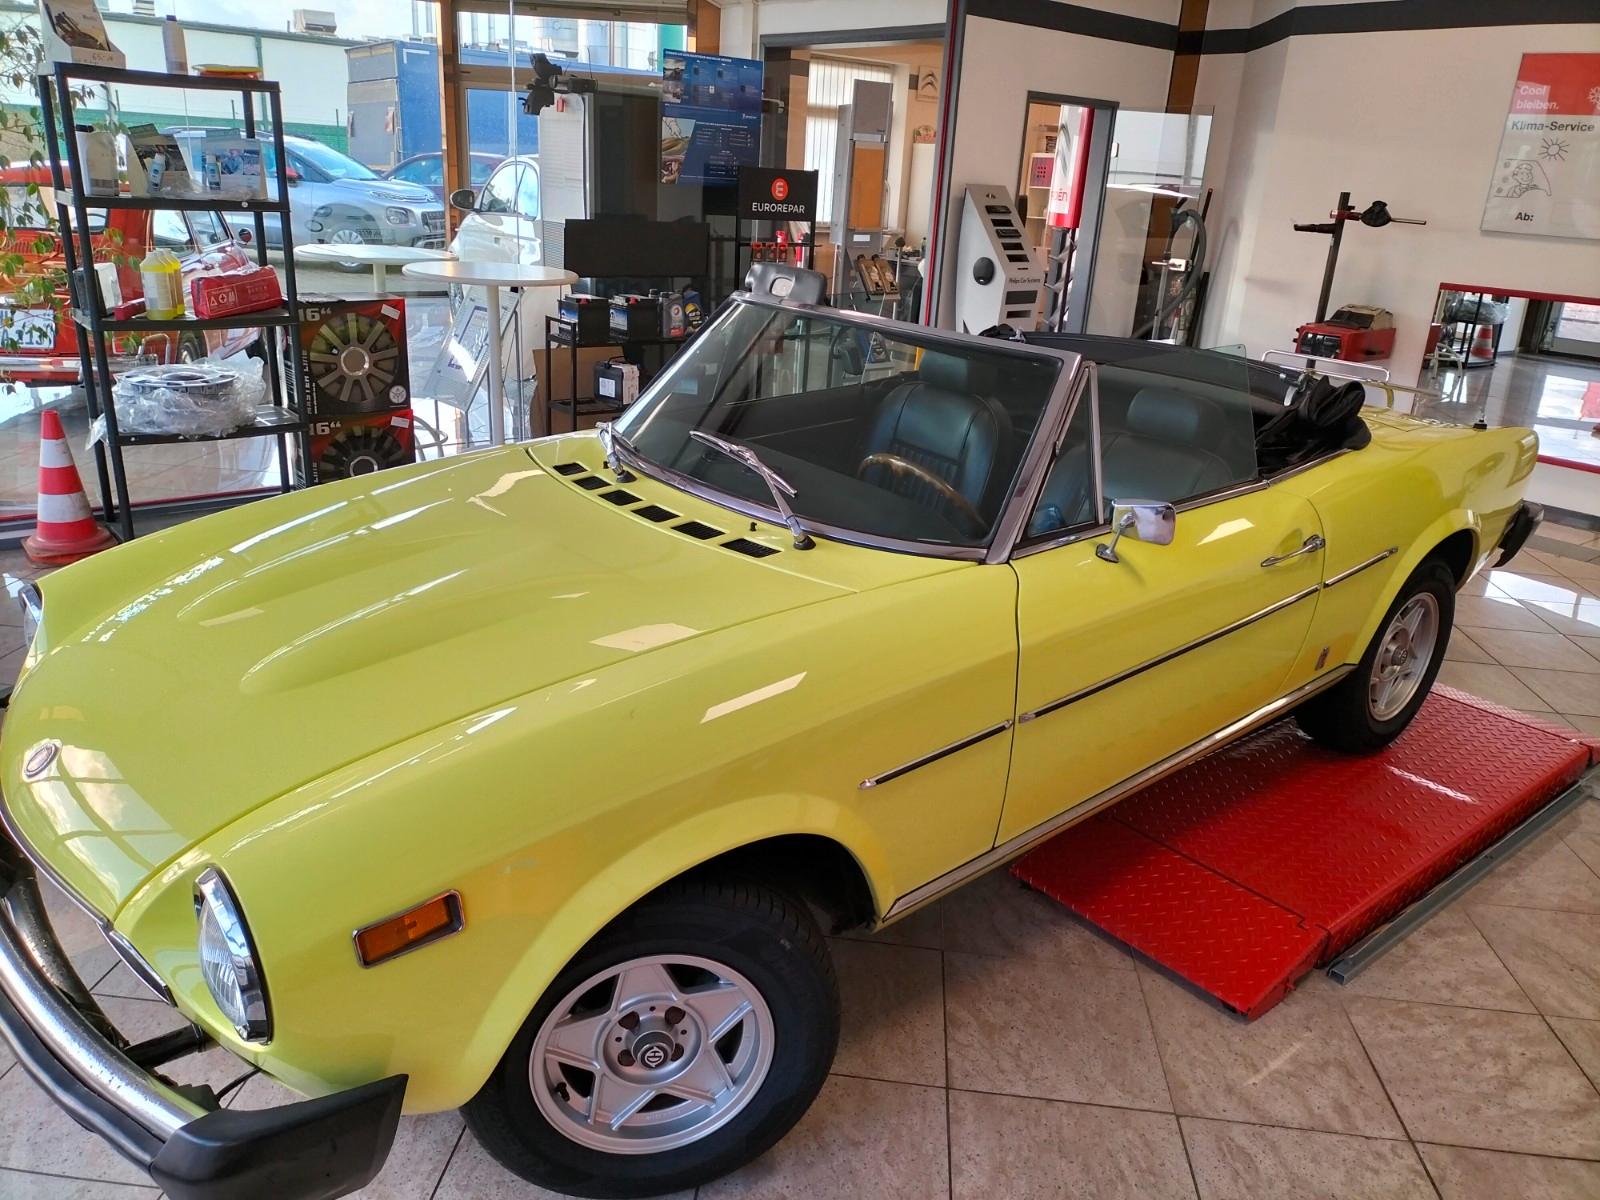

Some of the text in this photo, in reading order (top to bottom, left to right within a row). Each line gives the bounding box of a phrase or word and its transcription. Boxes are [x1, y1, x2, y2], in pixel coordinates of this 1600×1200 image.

[1520, 85, 1546, 96] Cool
[1516, 99, 1559, 110] bleiben.
[1511, 120, 1595, 132] Klima-Service
[752, 202, 806, 214] EUROREPAR
[1515, 212, 1535, 222] Ab:
